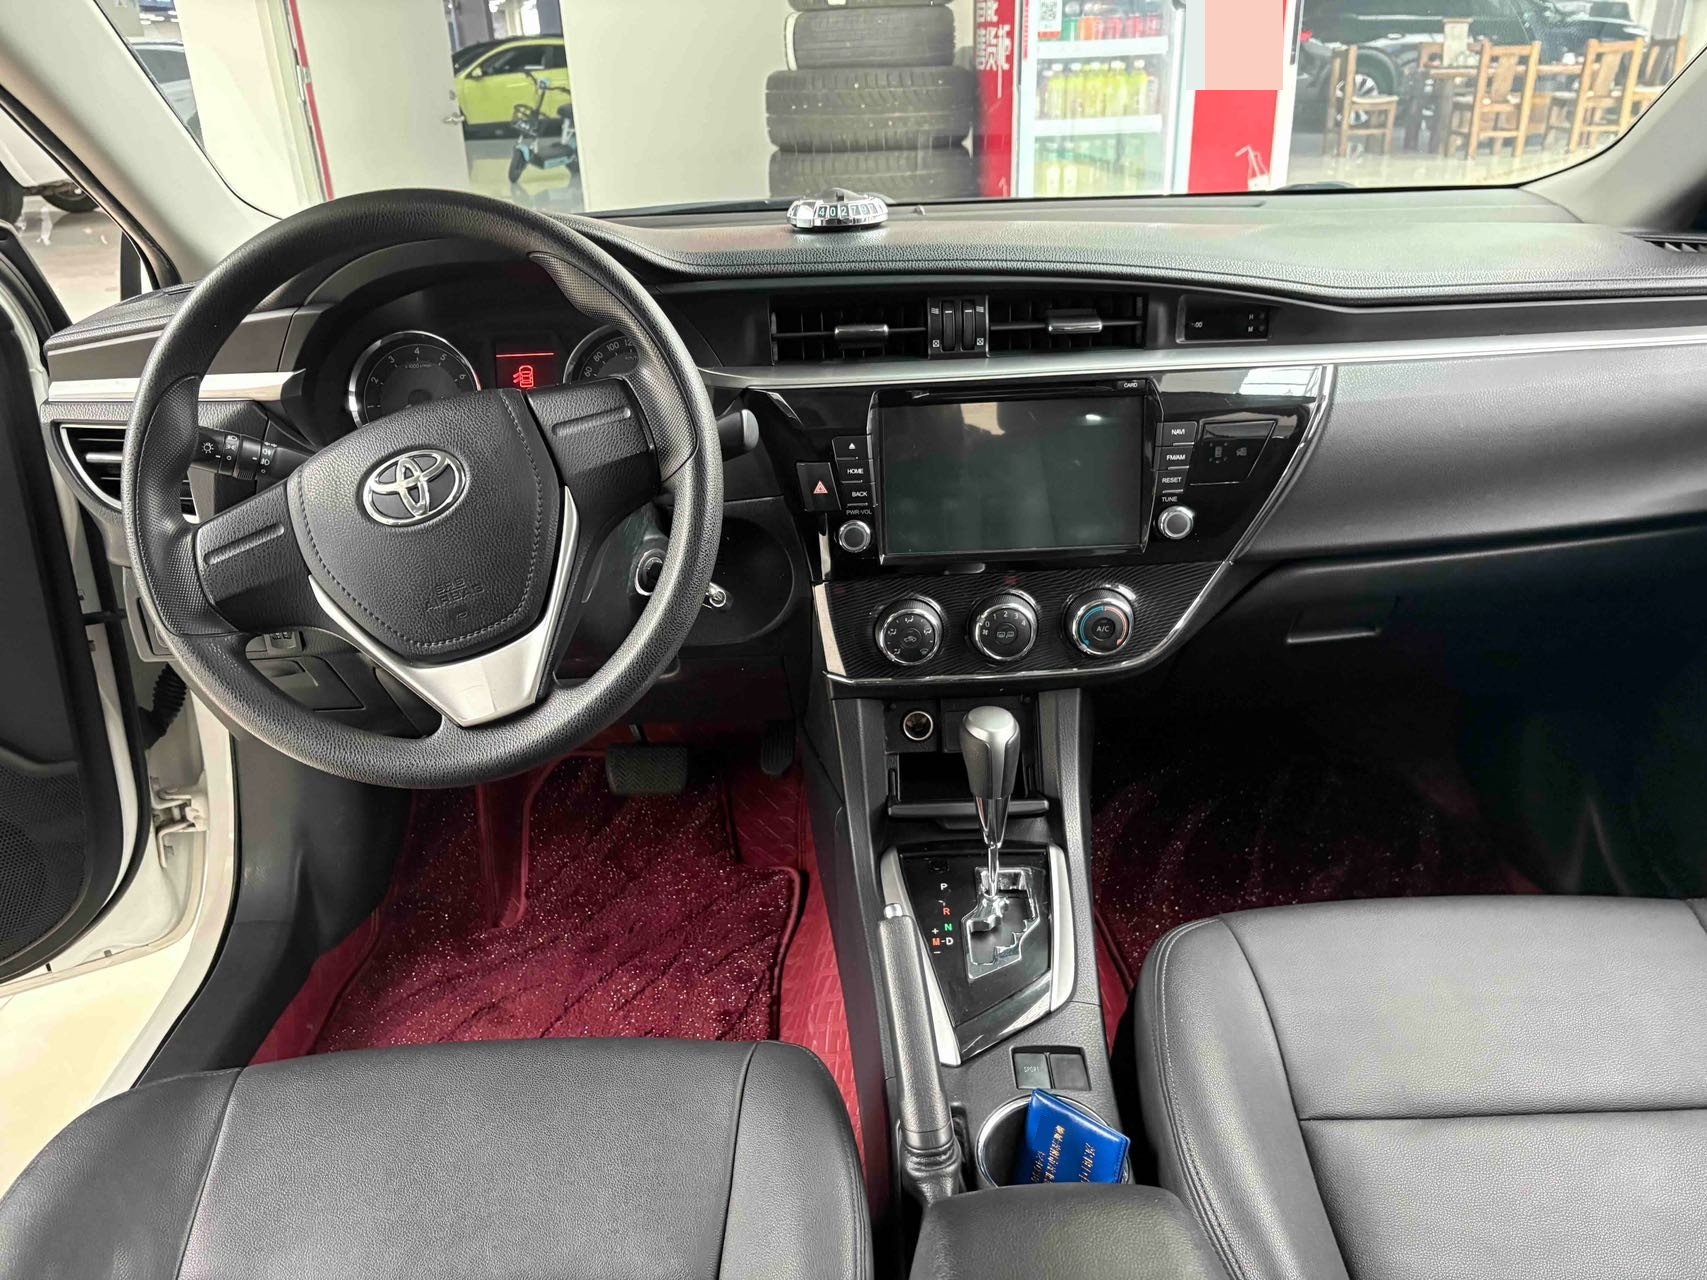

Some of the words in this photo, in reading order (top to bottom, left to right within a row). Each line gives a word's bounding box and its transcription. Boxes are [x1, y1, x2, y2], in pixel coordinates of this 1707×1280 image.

[583, 366, 593, 377] 60
[593, 351, 604, 362] 80
[606, 341, 620, 352] 100
[940, 882, 948, 890] P
[943, 907, 951, 915] R
[944, 923, 953, 931] N
